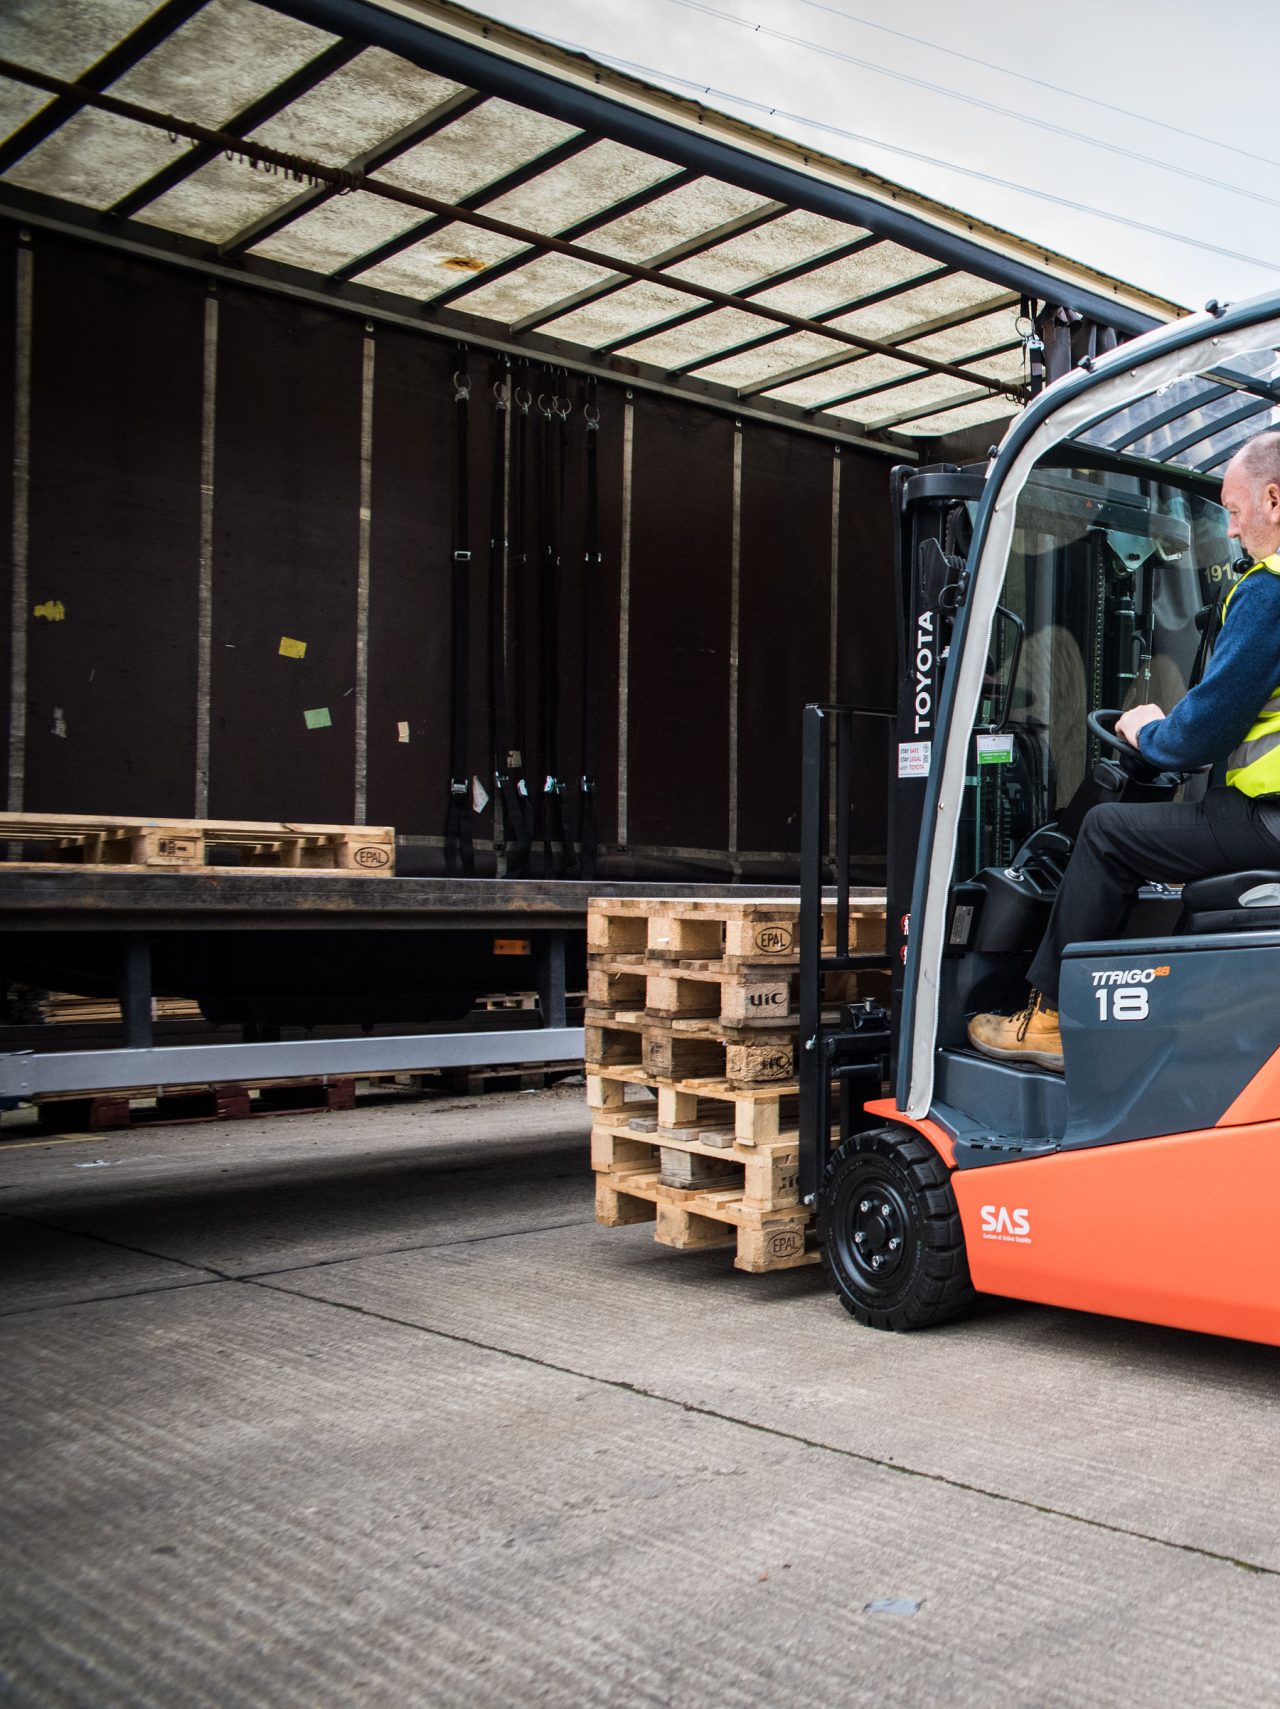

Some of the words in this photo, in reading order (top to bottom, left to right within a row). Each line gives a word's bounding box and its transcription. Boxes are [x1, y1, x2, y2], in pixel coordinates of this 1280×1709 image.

[914, 610, 934, 735] TOYOTA
[359, 851, 383, 863] EPAL
[761, 933, 787, 948] EPAL
[1095, 987, 1150, 1021] 18
[981, 1205, 1030, 1235] SAS
[773, 1236, 799, 1253] EPAL
